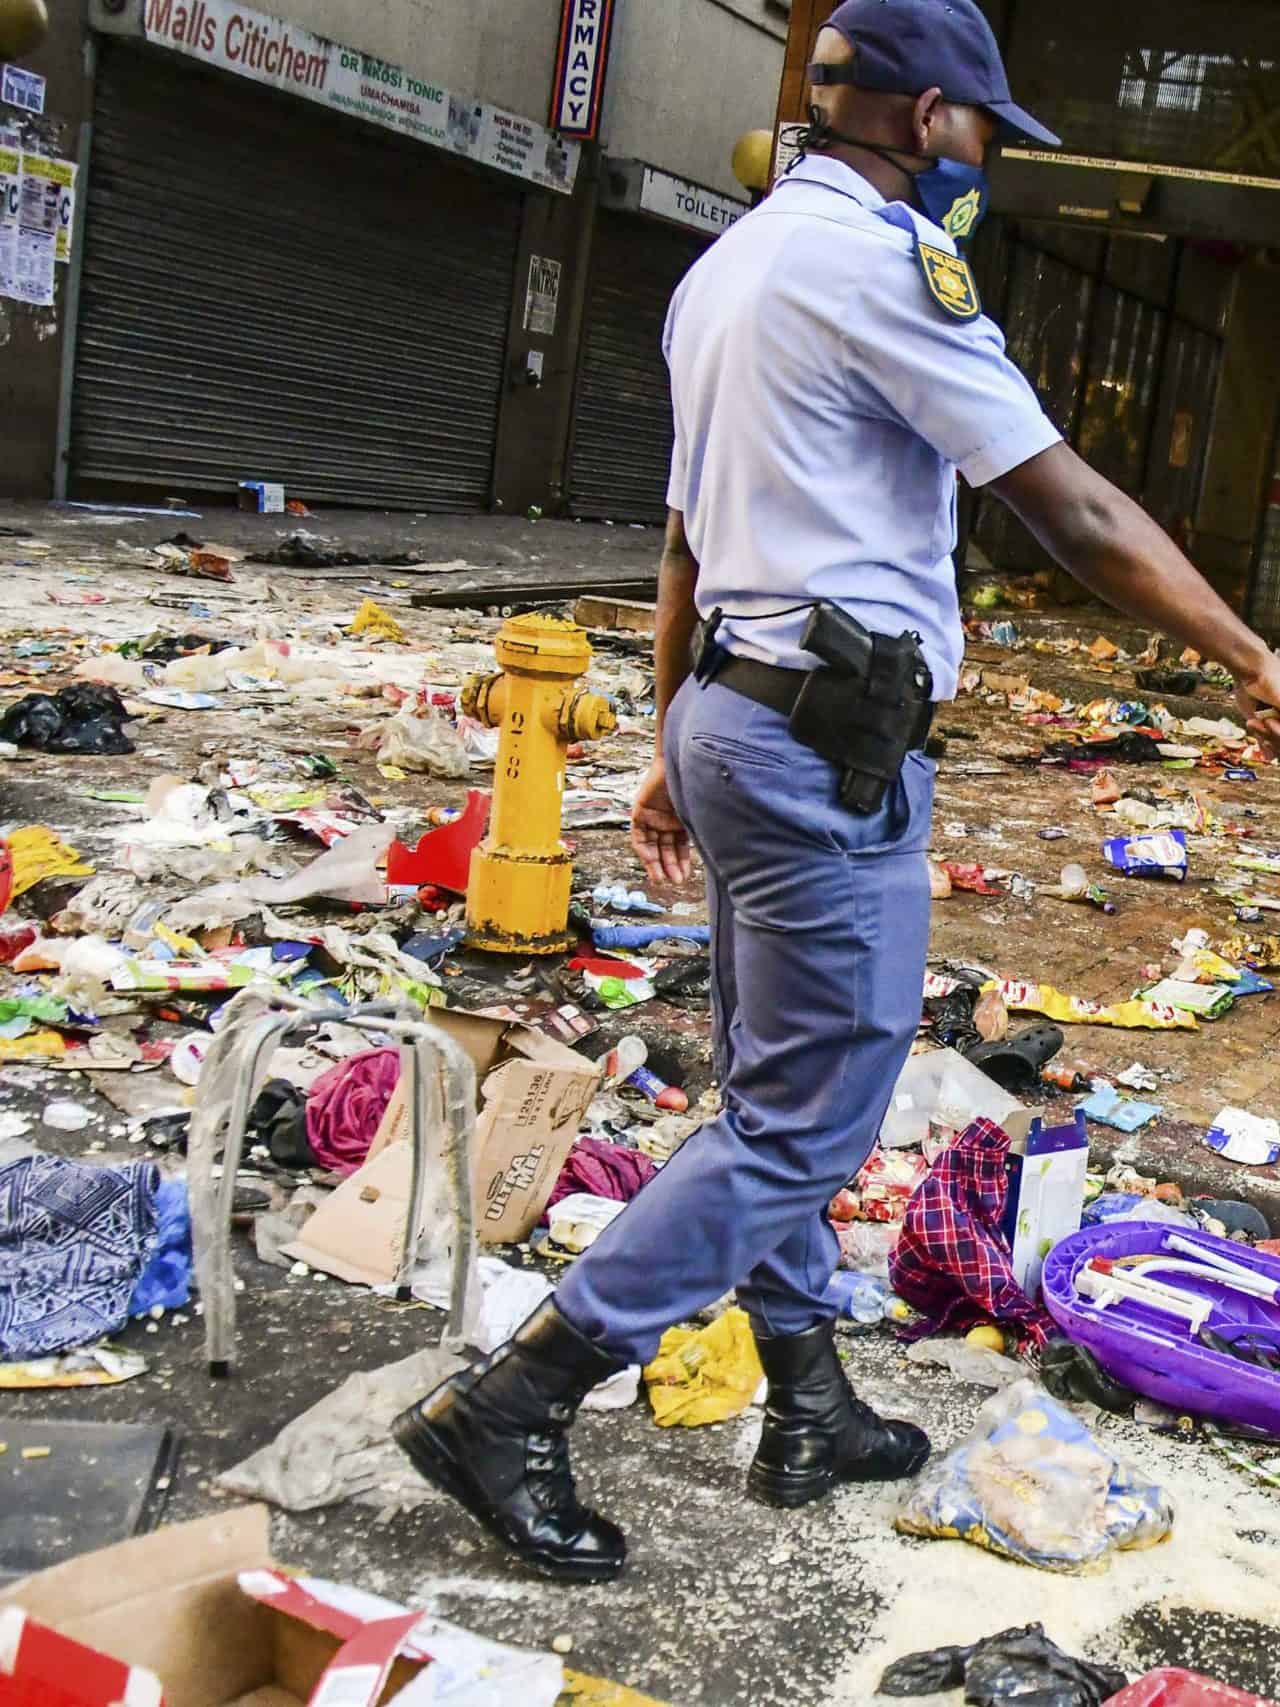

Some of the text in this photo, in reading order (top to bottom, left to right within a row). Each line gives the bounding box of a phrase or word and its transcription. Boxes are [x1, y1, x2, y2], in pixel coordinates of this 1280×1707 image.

[147, 0, 329, 90] Malls Citichem
[568, 0, 596, 122] RMACY
[340, 53, 444, 104] DR NKOSI TONIC
[676, 192, 742, 226] TOILETR
[485, 1154, 529, 1221] ULTRA
[515, 1144, 545, 1191] MEL
